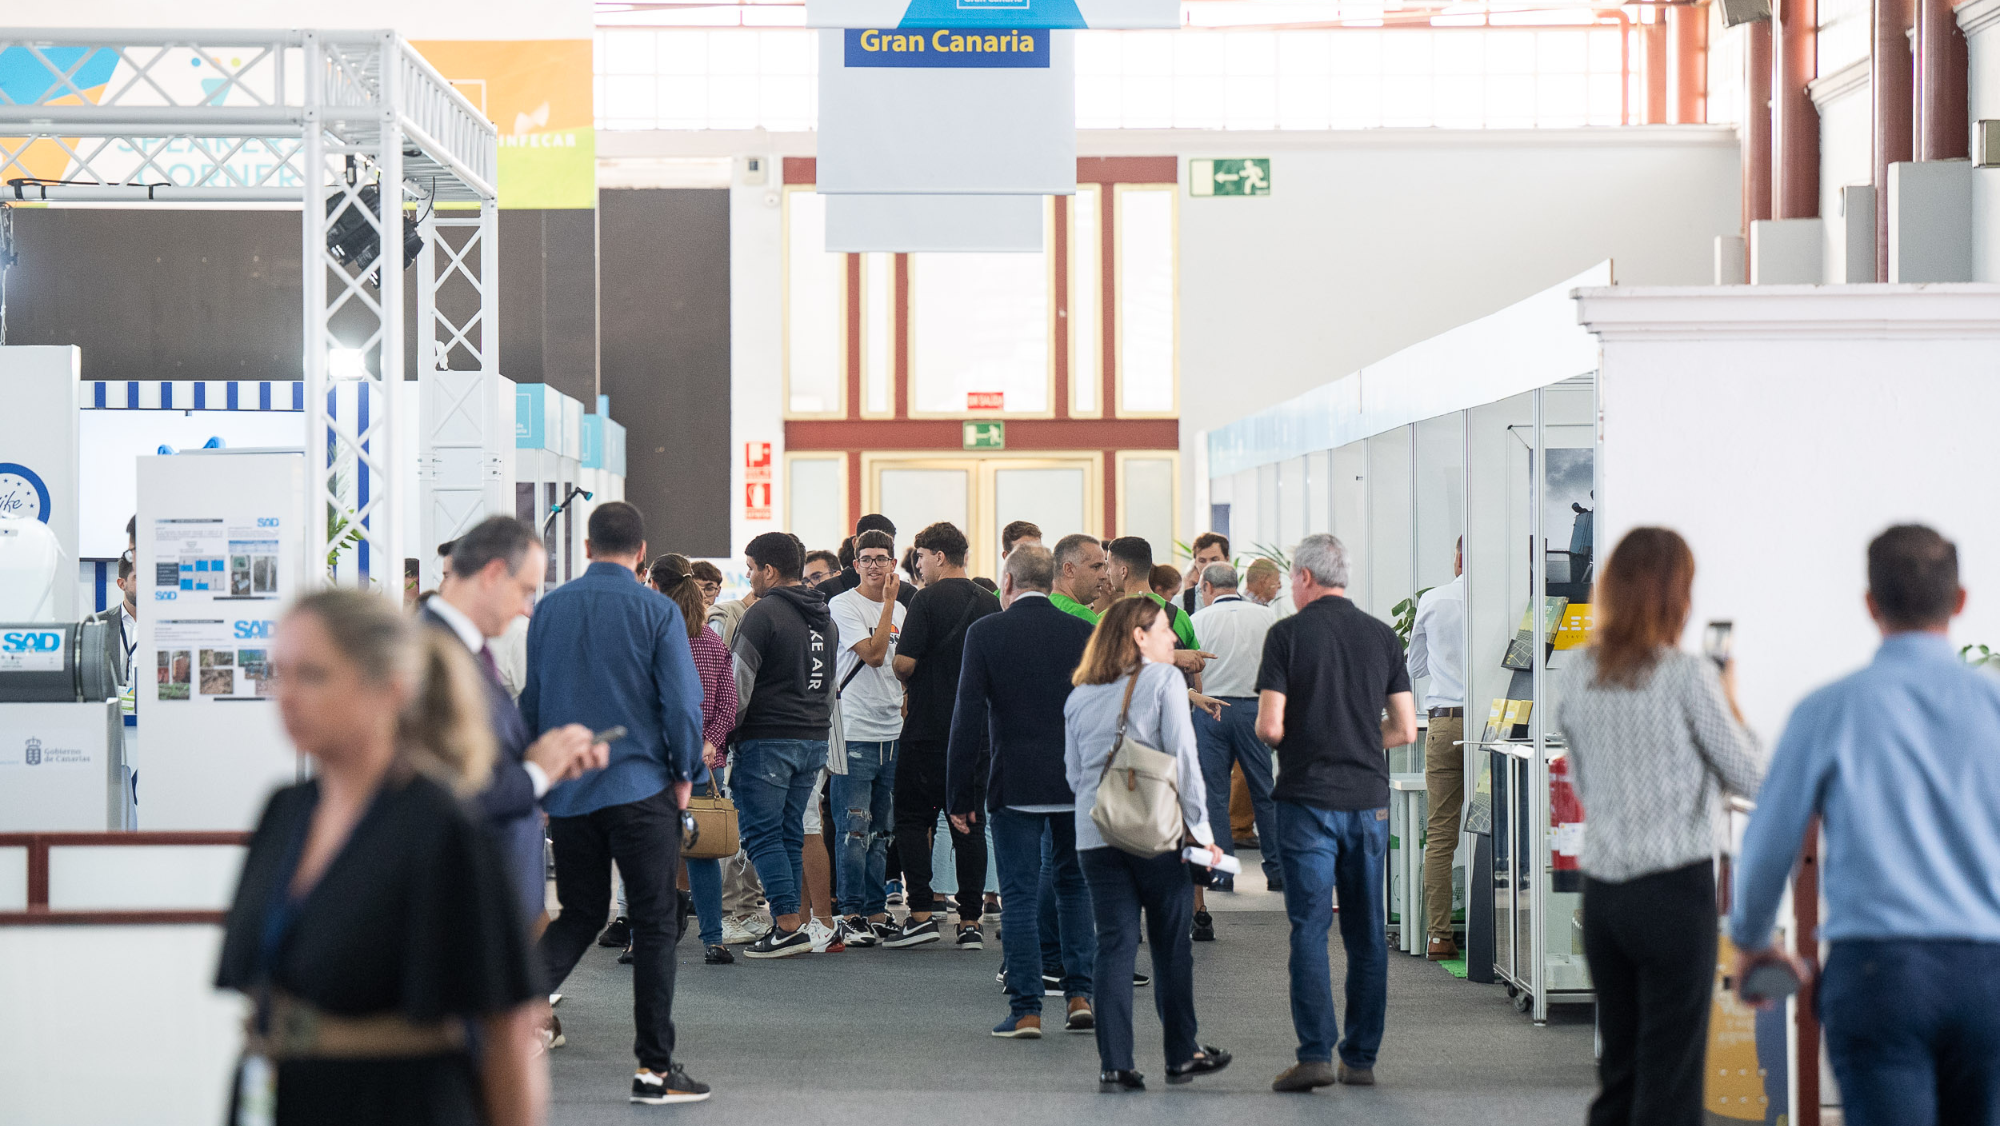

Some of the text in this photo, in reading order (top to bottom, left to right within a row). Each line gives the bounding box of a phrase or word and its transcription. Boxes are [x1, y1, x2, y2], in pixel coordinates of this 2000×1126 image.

[860, 29, 1035, 52] Gran Canaria
[498, 133, 577, 148] INFECAR
[257, 517, 279, 527] SAD
[155, 591, 177, 600] SAD
[233, 620, 277, 639] SAD
[2, 632, 61, 653] SAD
[808, 657, 823, 690] AIR
